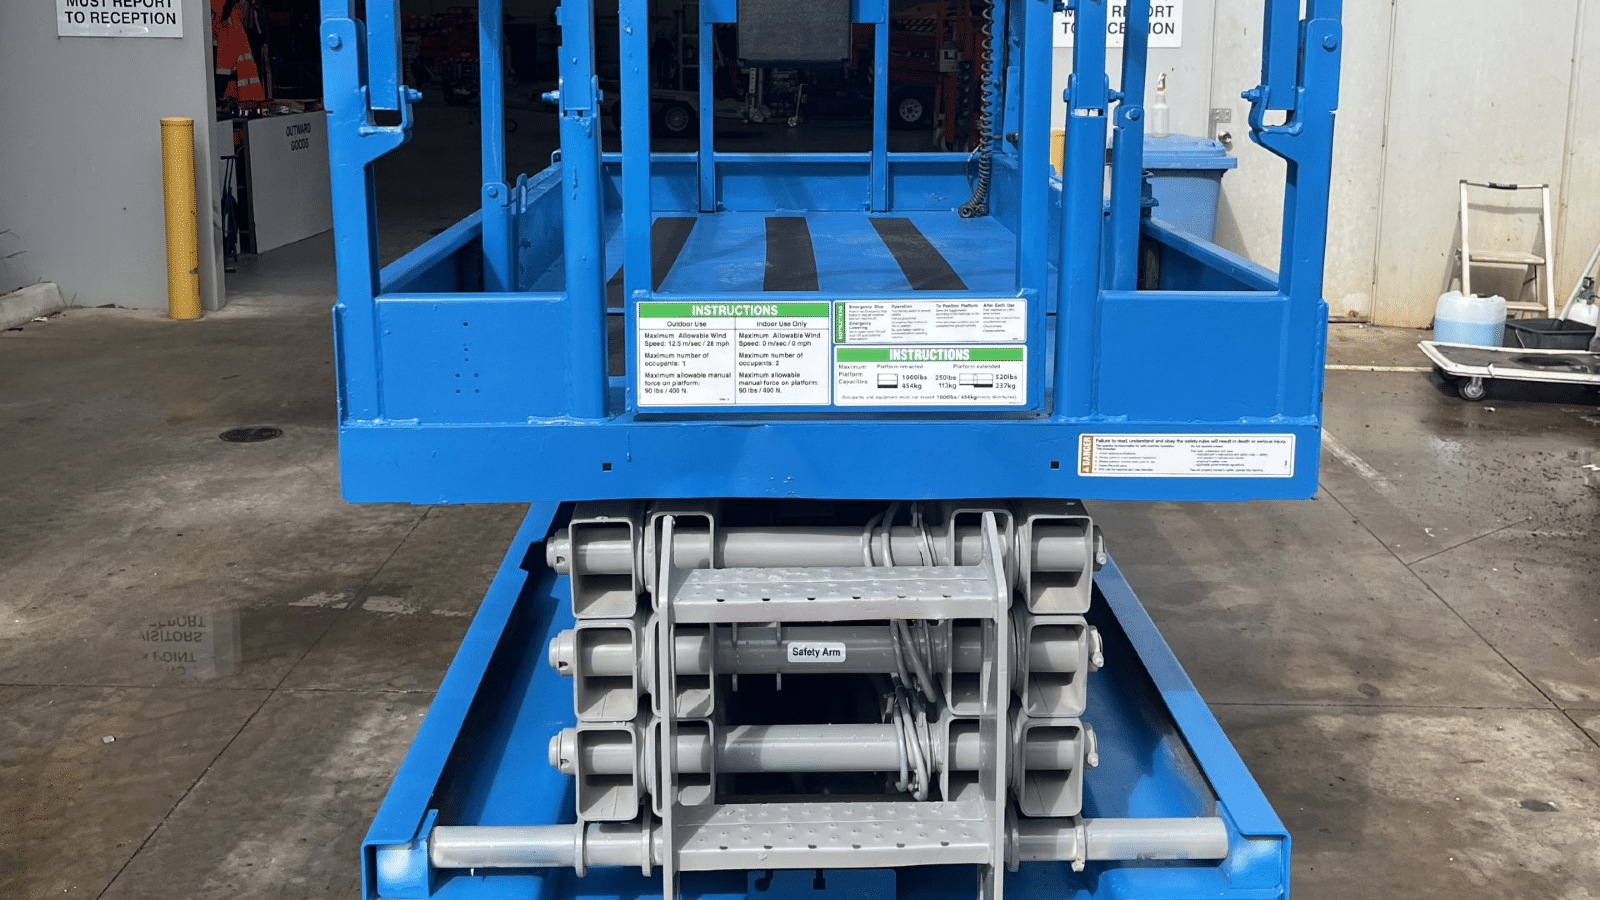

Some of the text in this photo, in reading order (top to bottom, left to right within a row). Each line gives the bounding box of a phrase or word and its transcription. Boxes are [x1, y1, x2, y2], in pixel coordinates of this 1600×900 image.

[65, 11, 176, 24] TO RECEPTION
[291, 138, 309, 151] GOODS
[691, 304, 779, 316] INSTRUCTIONS
[889, 348, 970, 360] INSTRUCTIONS
[792, 647, 840, 658] Safety Arm
